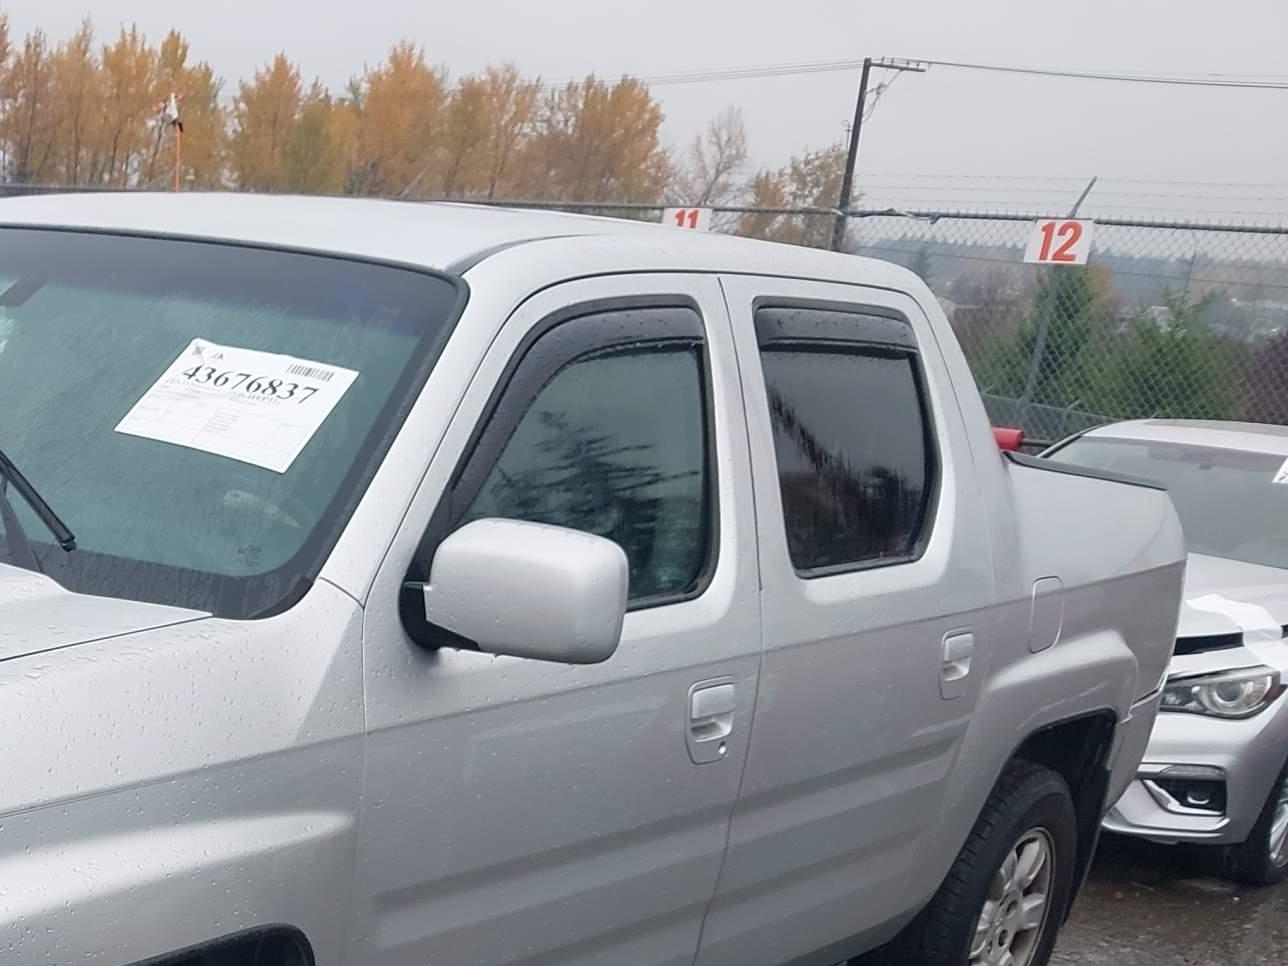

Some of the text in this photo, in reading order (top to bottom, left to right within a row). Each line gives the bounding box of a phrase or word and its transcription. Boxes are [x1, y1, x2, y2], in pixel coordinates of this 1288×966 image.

[674, 208, 700, 229] 11
[1038, 220, 1083, 262] 12
[182, 364, 321, 404] 43676837
